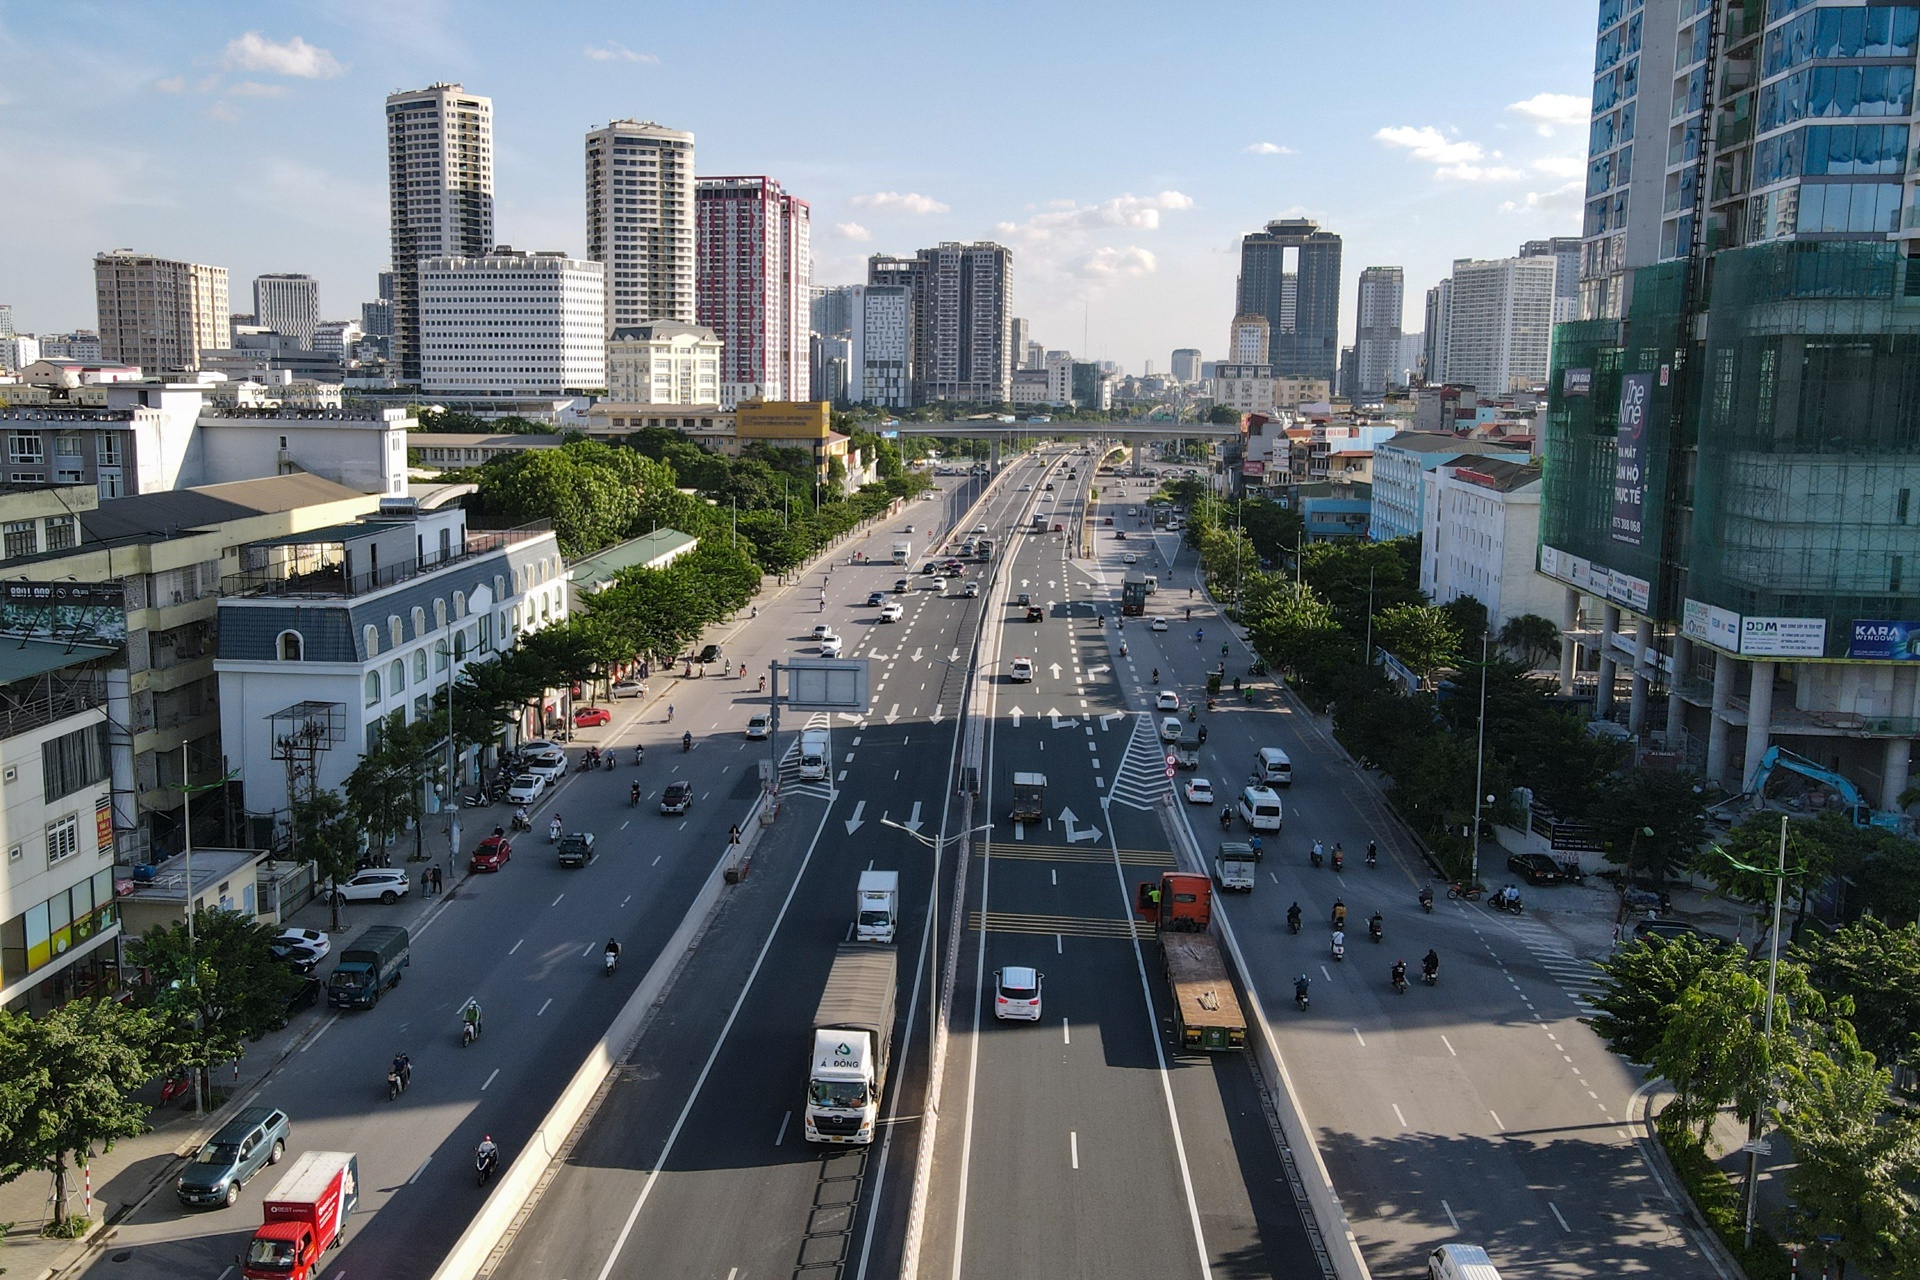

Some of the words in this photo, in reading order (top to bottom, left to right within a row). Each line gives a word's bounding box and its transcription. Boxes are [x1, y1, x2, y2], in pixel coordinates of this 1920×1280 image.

[1626, 379, 1645, 405] The
[1617, 400, 1642, 425] Nine
[1626, 464, 1639, 485] HỘ
[1629, 486, 1641, 505] TẾ
[1746, 621, 1778, 632] DDM
[1855, 625, 1899, 636] KARA
[821, 1057, 827, 1068] Á
[833, 1058, 859, 1069] ĐÔNG
